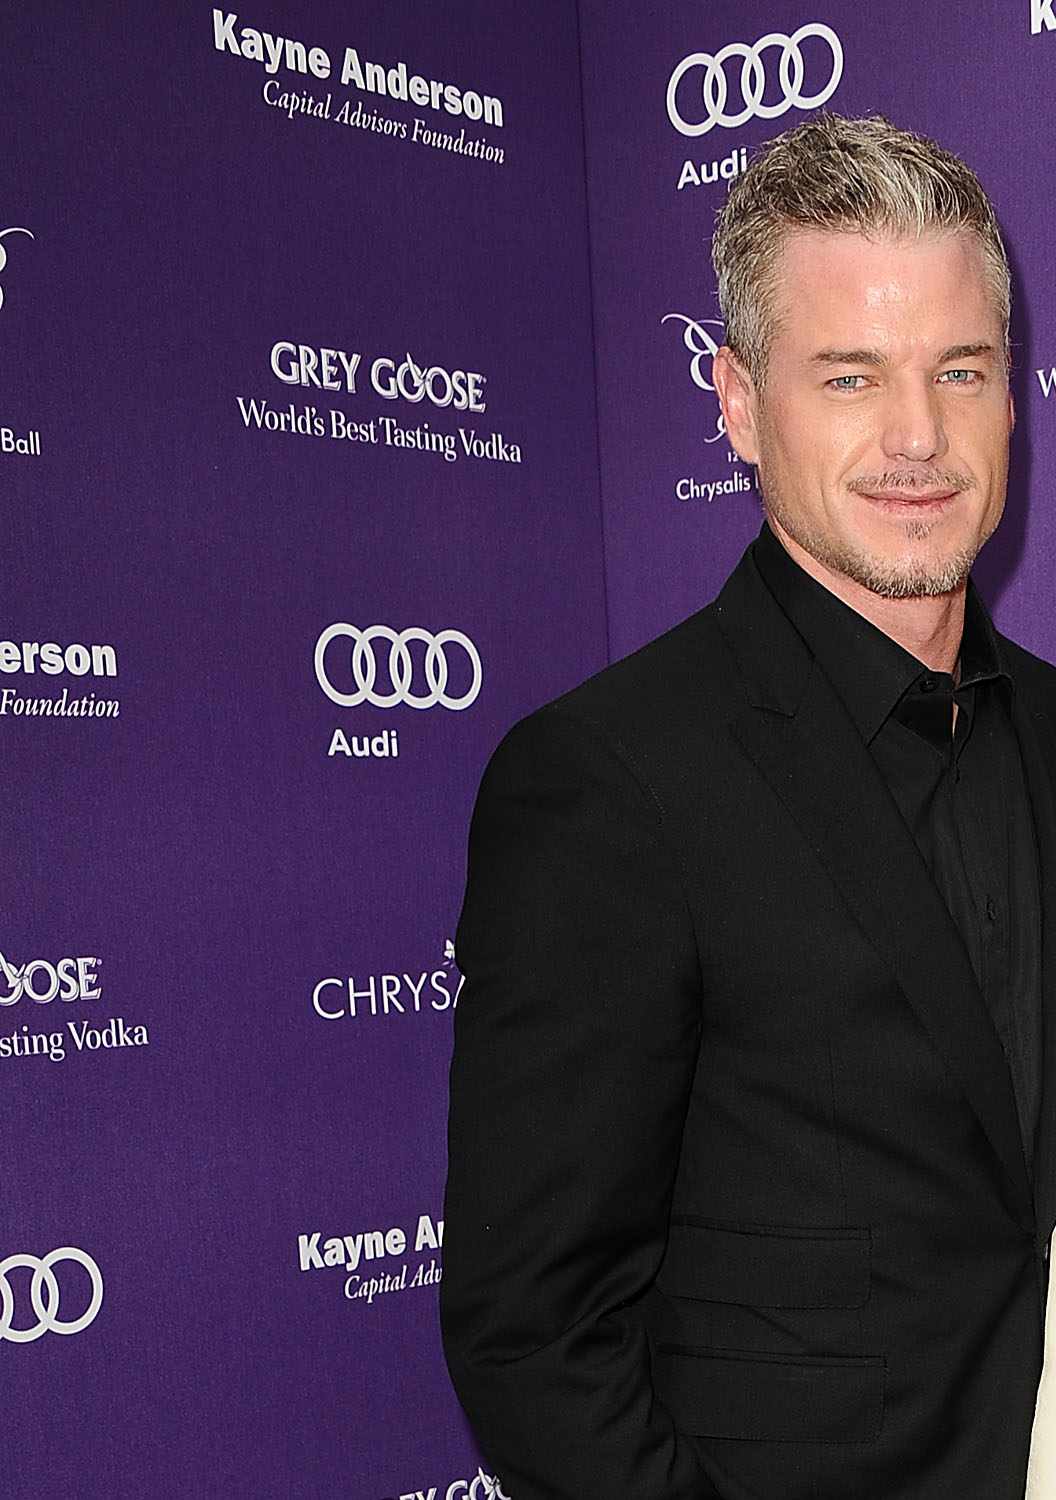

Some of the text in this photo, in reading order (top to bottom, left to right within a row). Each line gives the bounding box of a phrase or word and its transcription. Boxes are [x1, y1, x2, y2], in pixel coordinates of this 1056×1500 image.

[213, 8, 503, 127] Kayne Anderson
[263, 80, 504, 164] Capital Advisors Foundation
[677, 147, 747, 190] Audi
[270, 341, 486, 413] GREY GOOSE
[0, 427, 41, 456] Ball
[237, 397, 522, 463] World's Best Tasting Vodka
[727, 450, 740, 463] 12
[676, 471, 751, 502] Chrysalis
[0, 640, 117, 677] erson
[0, 688, 120, 718] Foundation
[327, 728, 398, 758] Audi
[312, 970, 466, 1020] CHRYS
[0, 1017, 149, 1062] sting Vodka
[299, 1228, 407, 1272] Kayne
[344, 1264, 408, 1304] Capital
